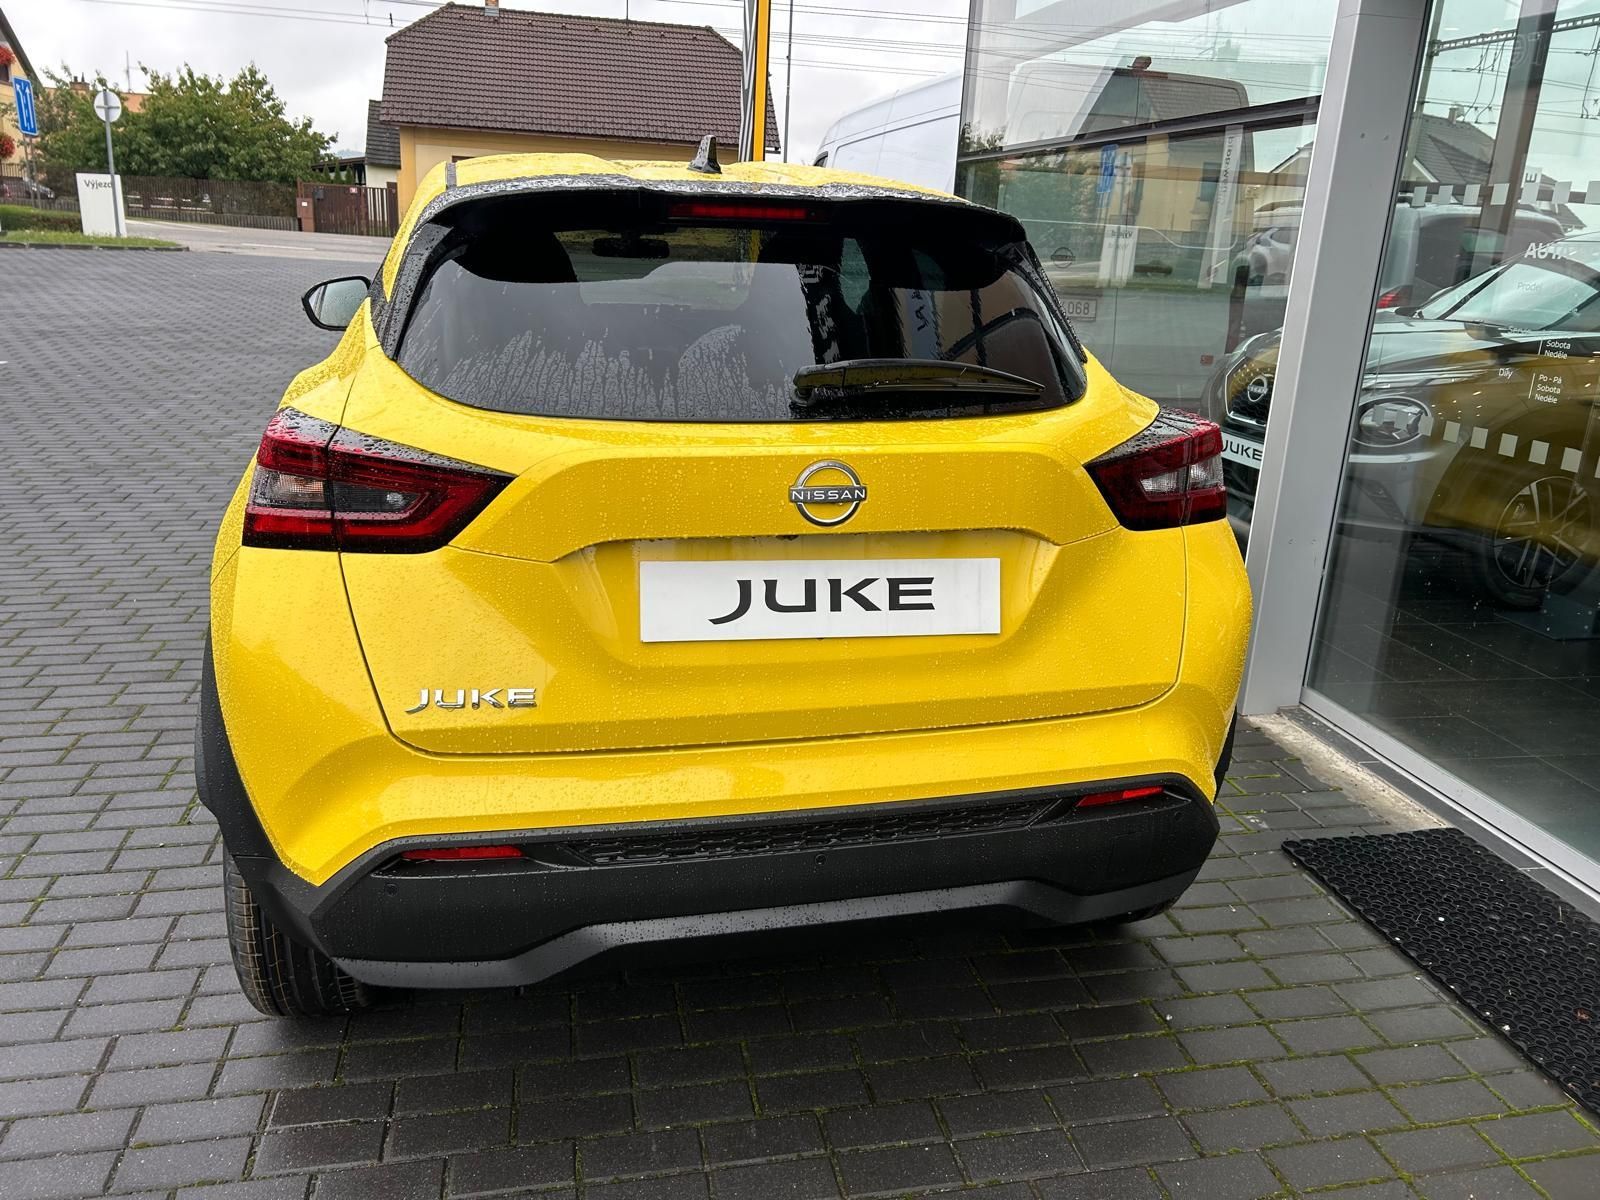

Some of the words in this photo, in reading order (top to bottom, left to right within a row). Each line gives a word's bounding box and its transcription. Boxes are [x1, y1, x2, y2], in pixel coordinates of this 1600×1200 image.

[1060, 301, 1090, 316] 068
[1546, 340, 1571, 350] Sobota
[1544, 349, 1568, 360] Neděle
[1536, 383, 1561, 394] Sobota
[1534, 393, 1558, 404] Neděle
[1222, 440, 1263, 462] JUKE
[792, 489, 866, 500] NISSAN
[708, 576, 935, 625] JUKE
[404, 688, 538, 714] JUKE
